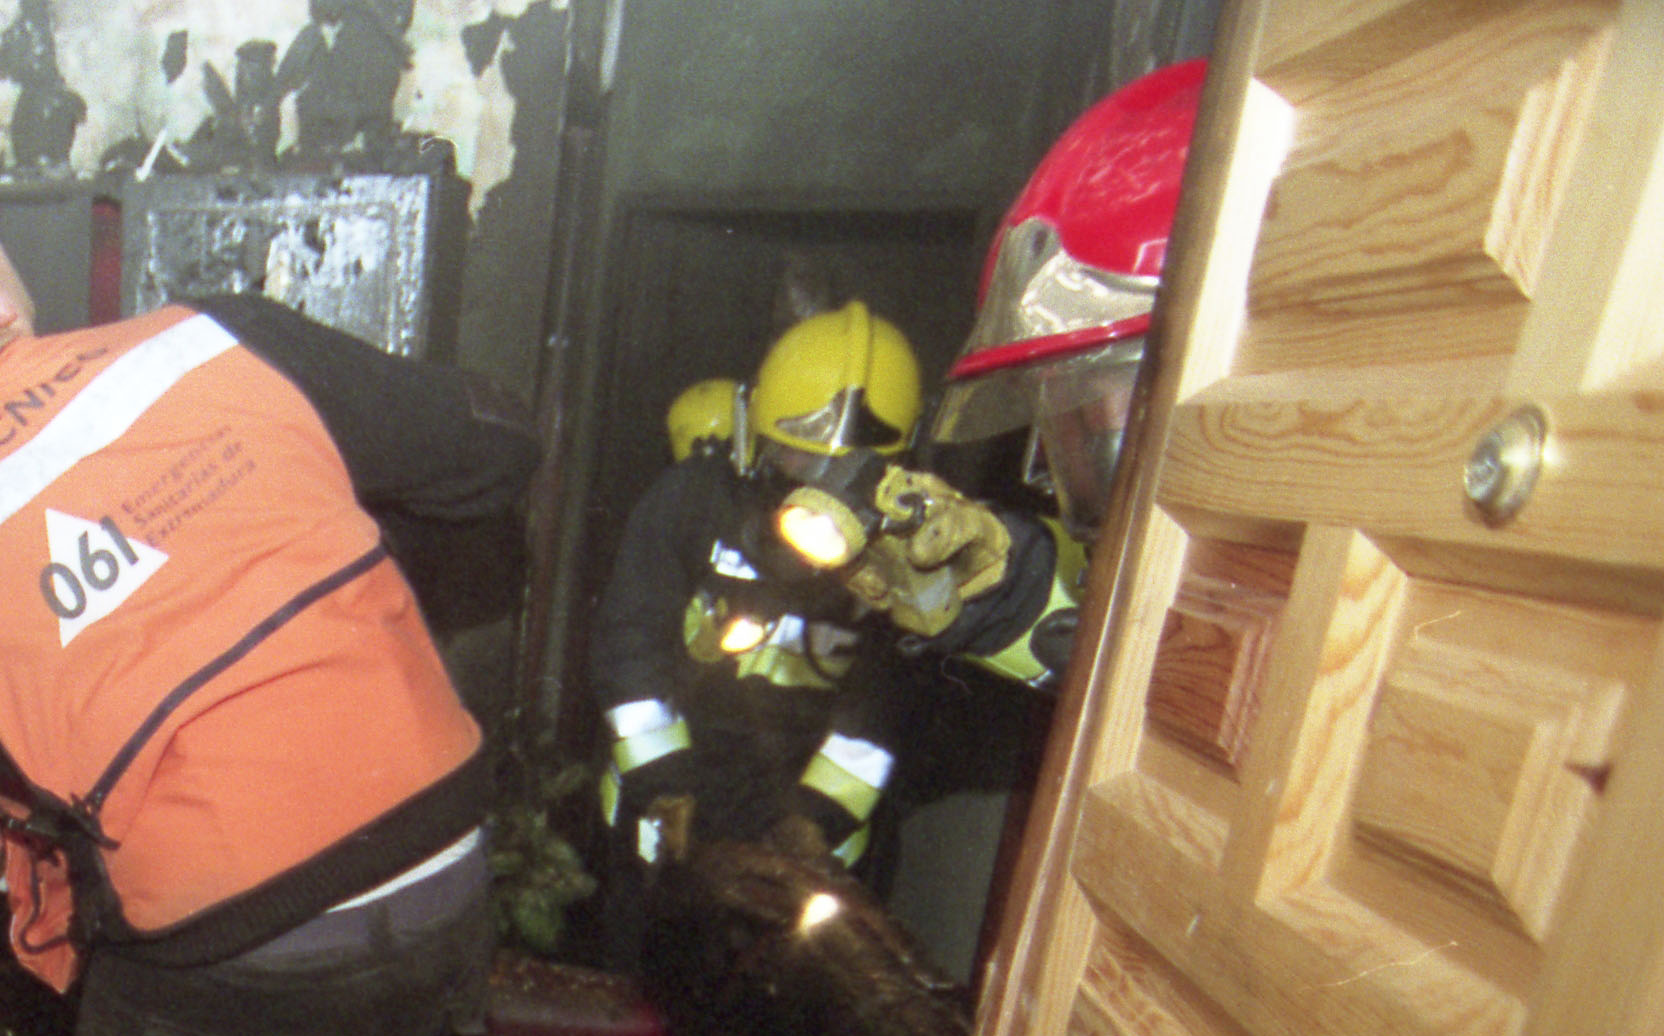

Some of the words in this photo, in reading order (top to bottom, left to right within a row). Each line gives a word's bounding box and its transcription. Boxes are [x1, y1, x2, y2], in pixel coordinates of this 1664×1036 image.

[134, 462, 218, 526] Sanitarias
[222, 441, 243, 462] de
[39, 515, 140, 620] 061
